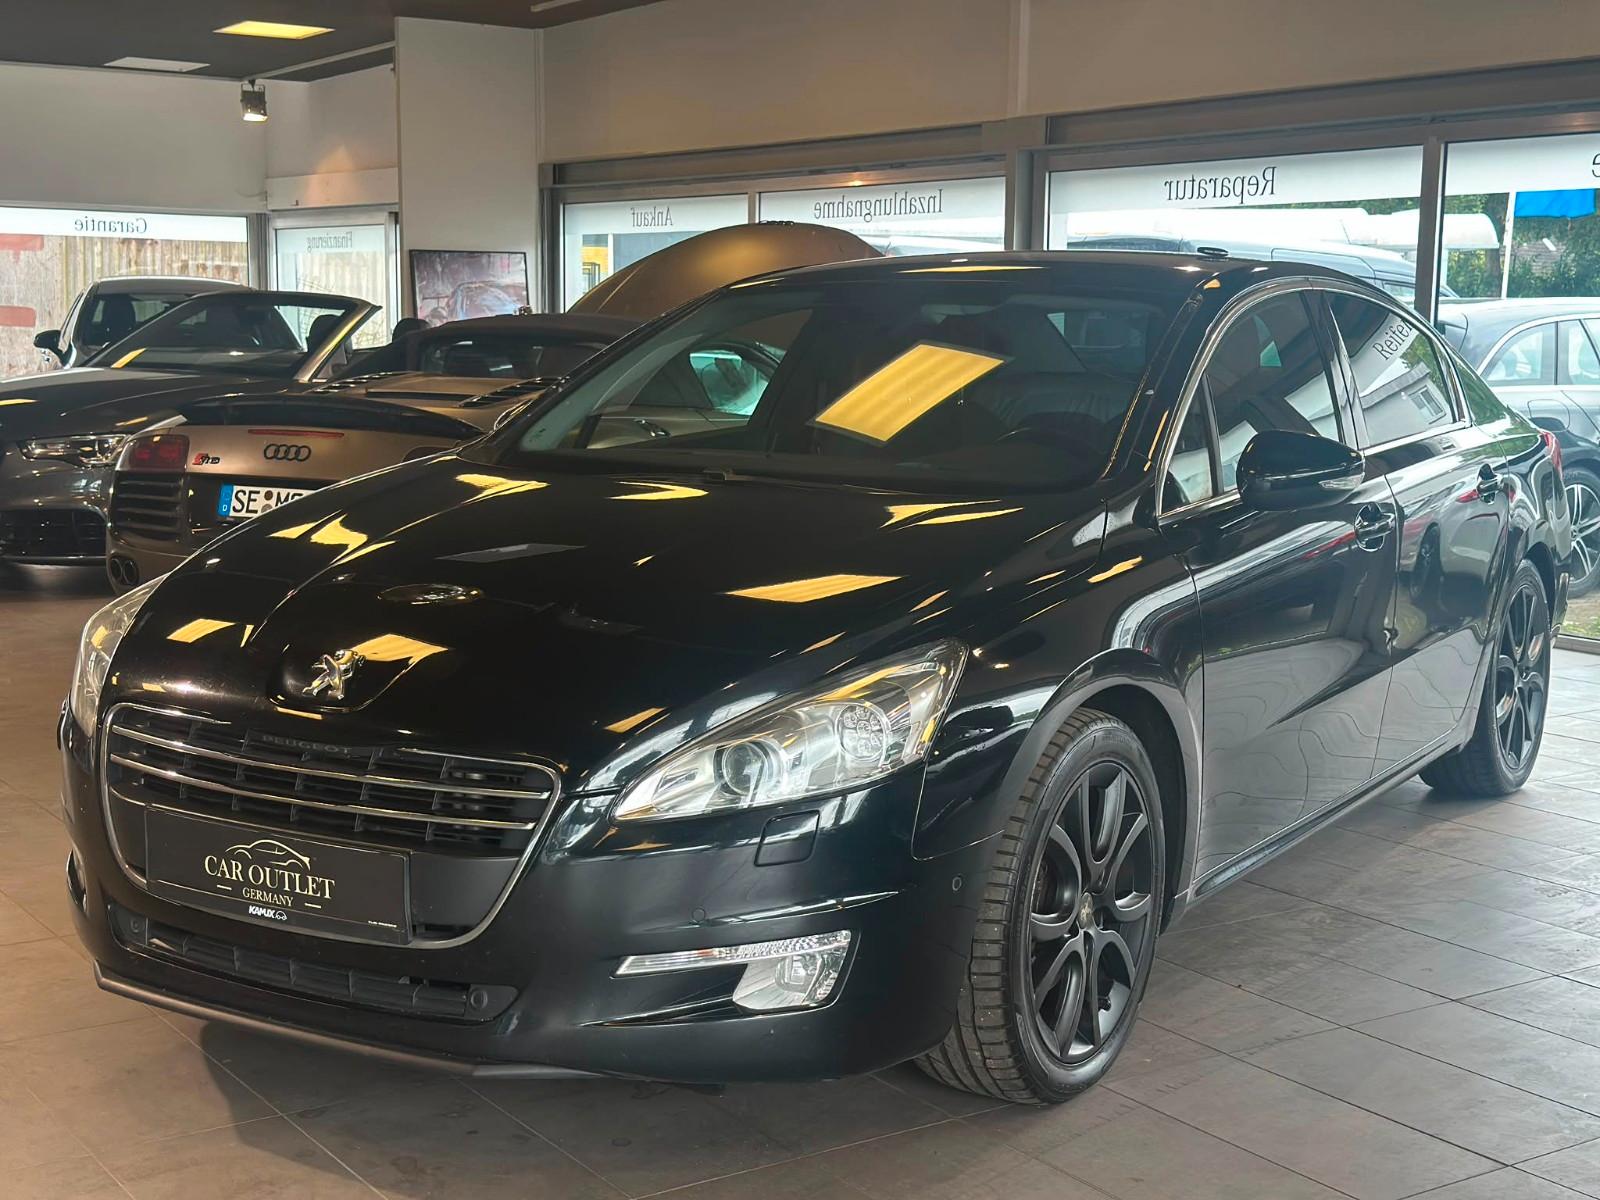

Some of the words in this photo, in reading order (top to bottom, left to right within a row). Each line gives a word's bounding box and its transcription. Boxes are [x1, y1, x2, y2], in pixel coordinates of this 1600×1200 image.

[232, 489, 260, 514] SE
[262, 735, 353, 754] PEUGEOT
[204, 855, 245, 883] CAR
[248, 864, 336, 900] OUTLET
[242, 887, 294, 907] GERMANY
